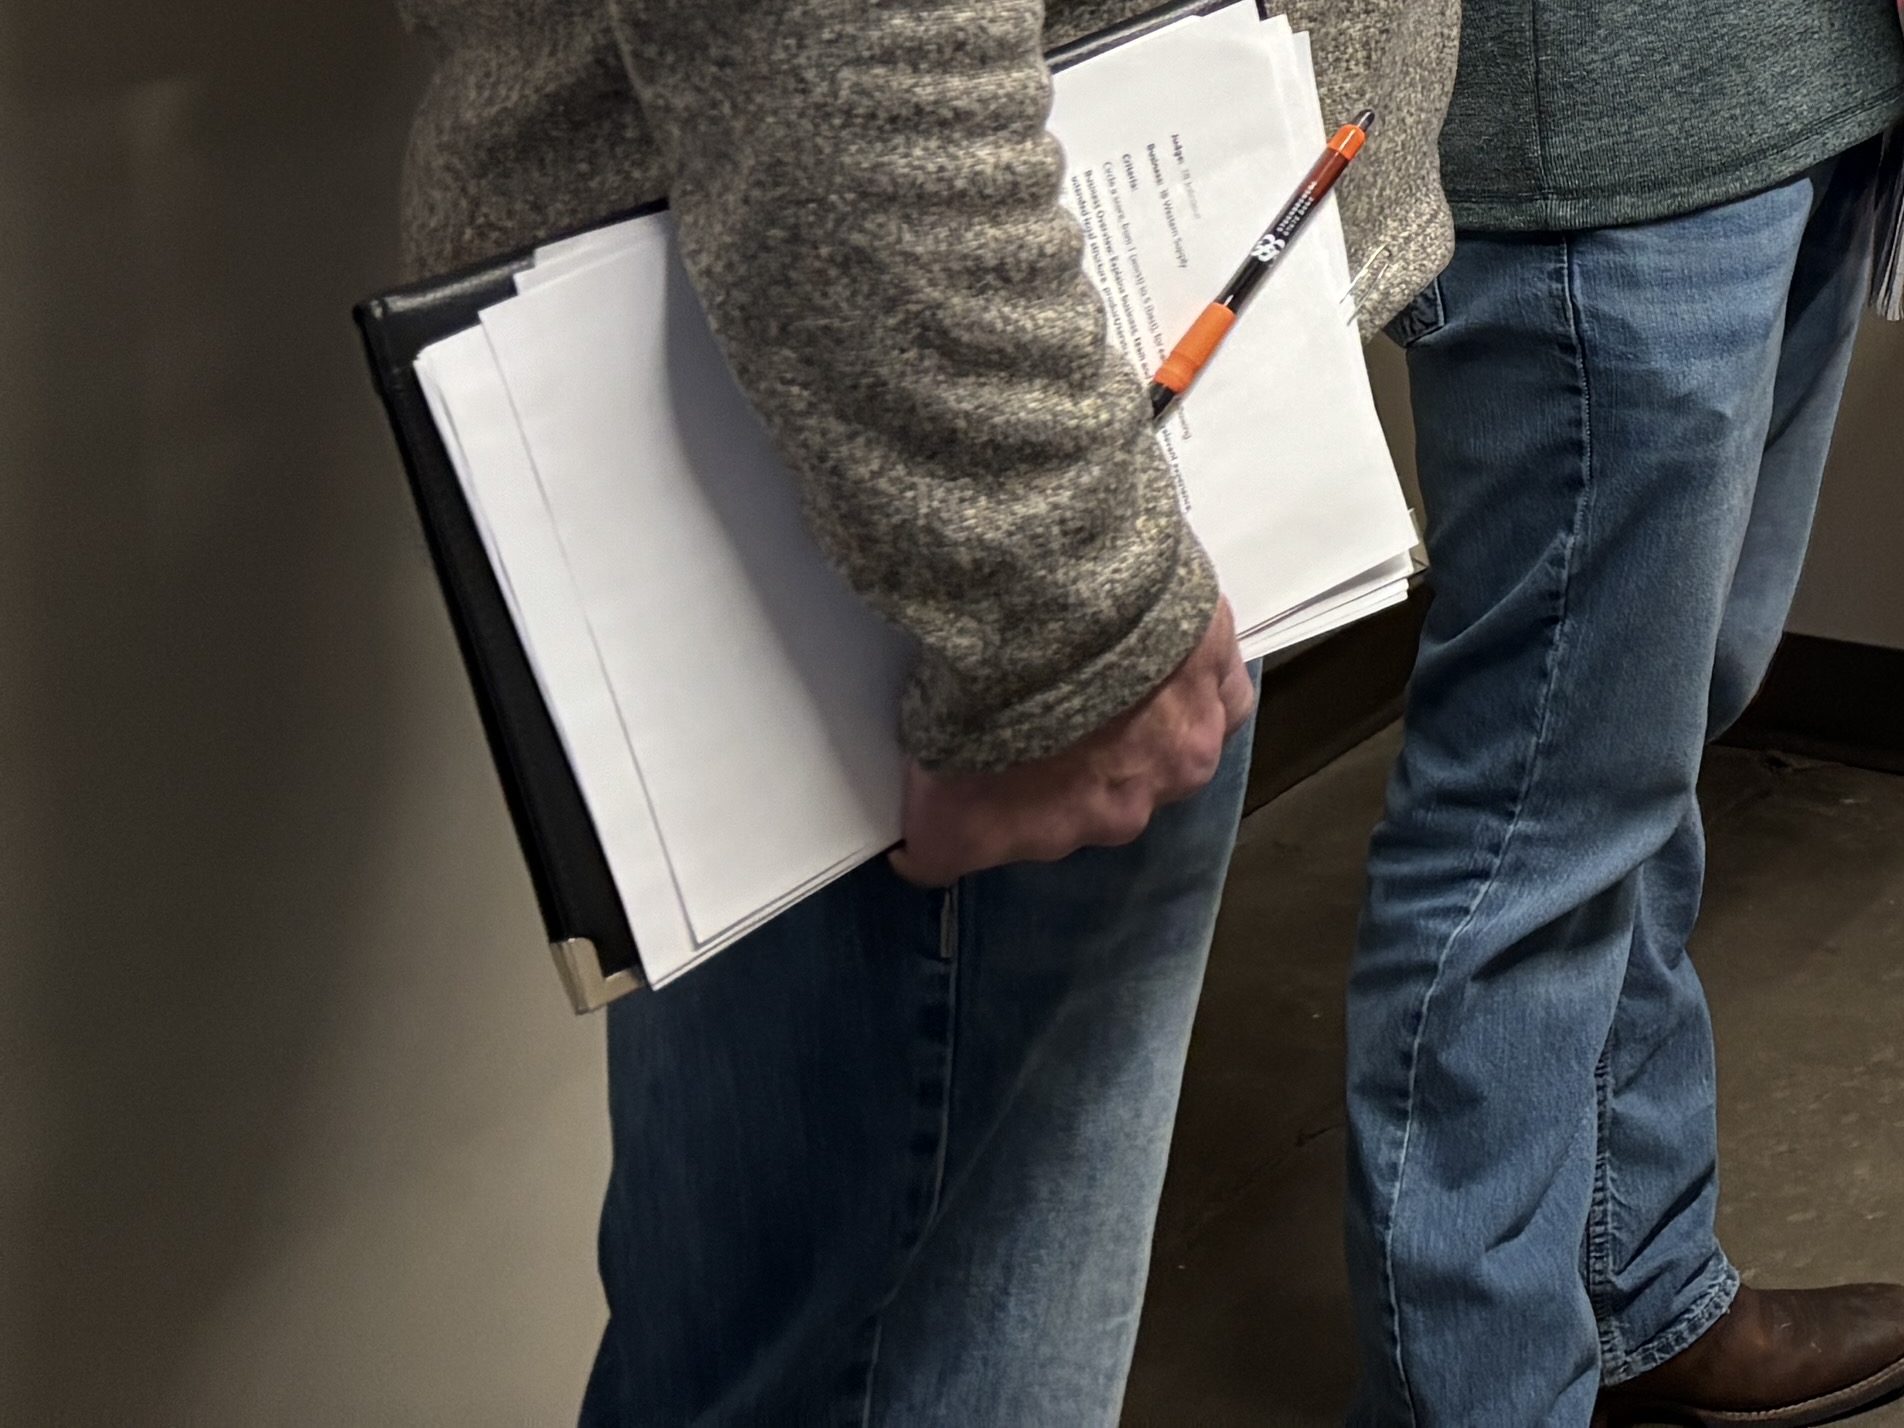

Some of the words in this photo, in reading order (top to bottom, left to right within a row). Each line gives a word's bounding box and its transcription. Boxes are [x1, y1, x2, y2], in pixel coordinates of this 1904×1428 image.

[1121, 152, 1142, 192] Criteria:
[1145, 143, 1167, 186] Business:
[1162, 199, 1181, 237] Western
[1170, 237, 1190, 270] Supply
